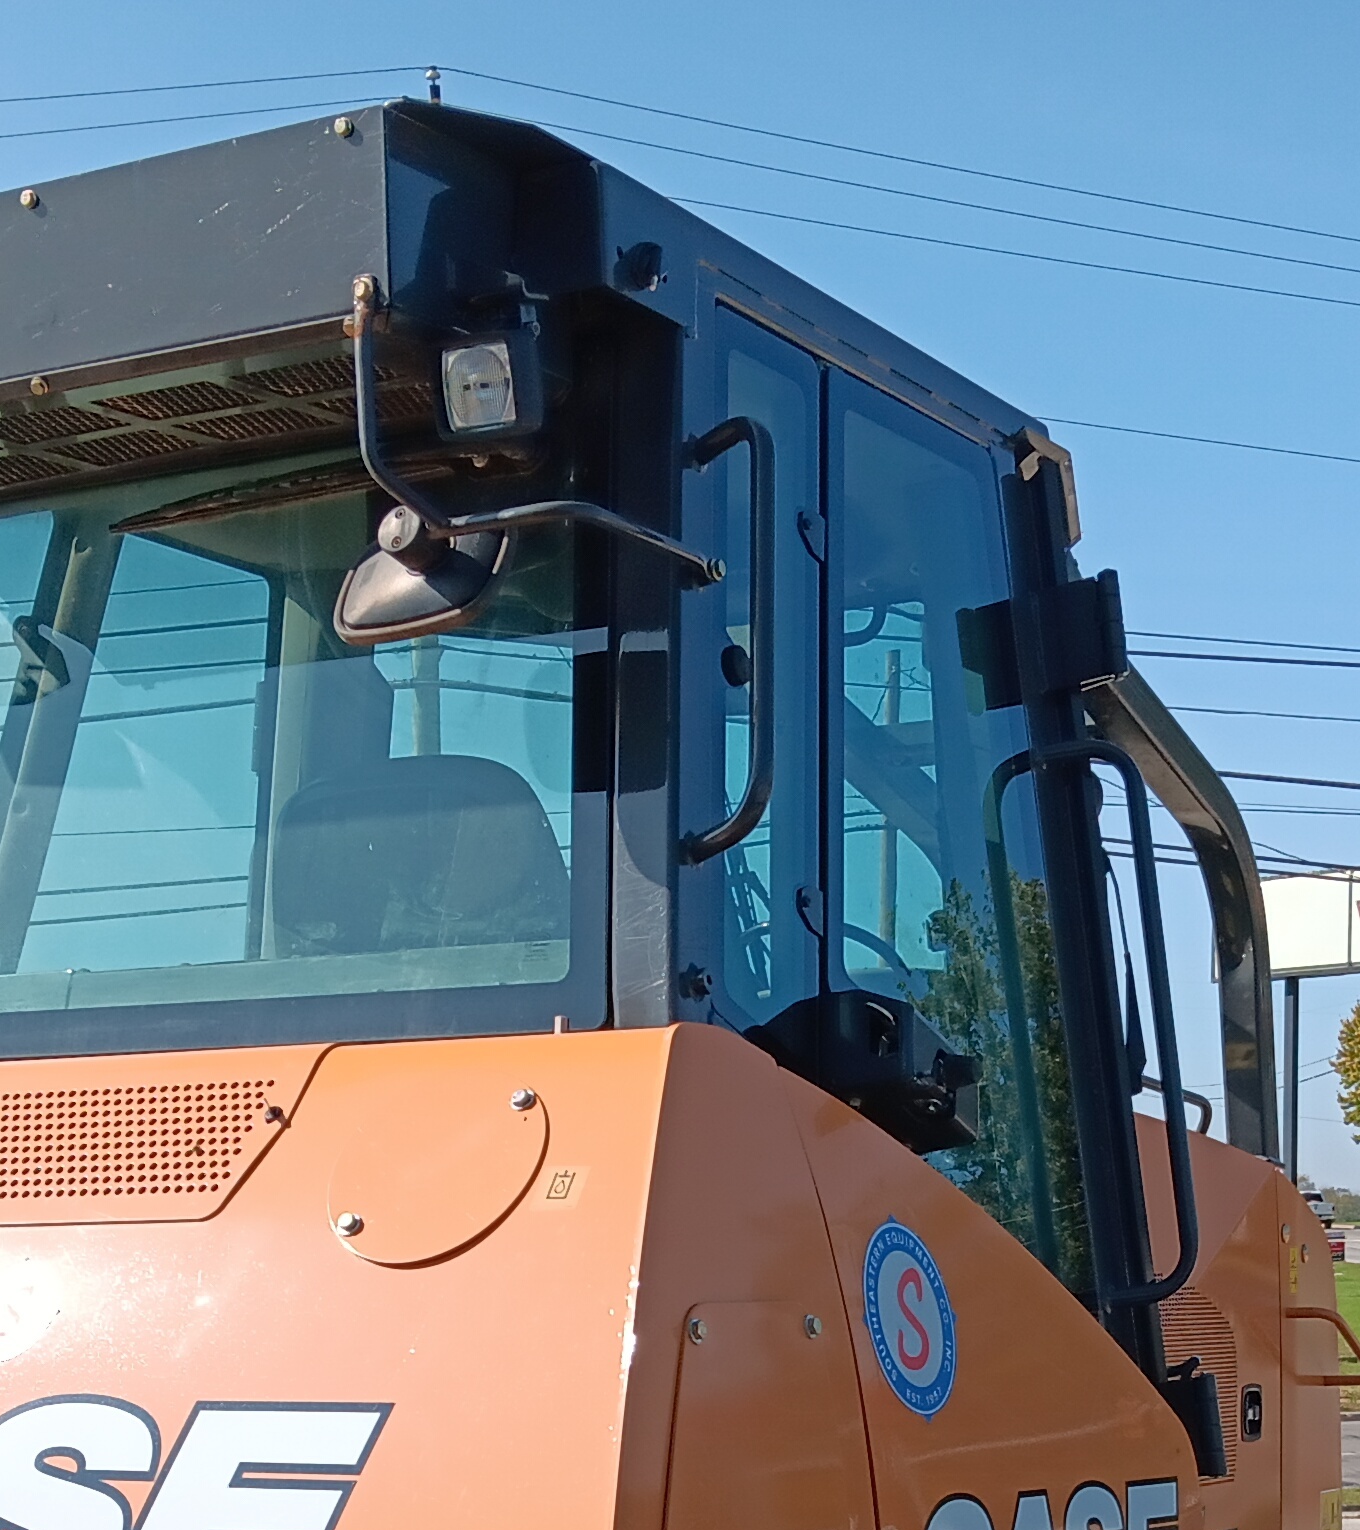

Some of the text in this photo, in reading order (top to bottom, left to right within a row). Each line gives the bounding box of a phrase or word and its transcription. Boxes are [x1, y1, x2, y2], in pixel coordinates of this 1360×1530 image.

[868, 1239, 898, 1381] SOUTHEASTERN
[885, 1232, 939, 1288] EQUIPMENT
[897, 1268, 929, 1370] S
